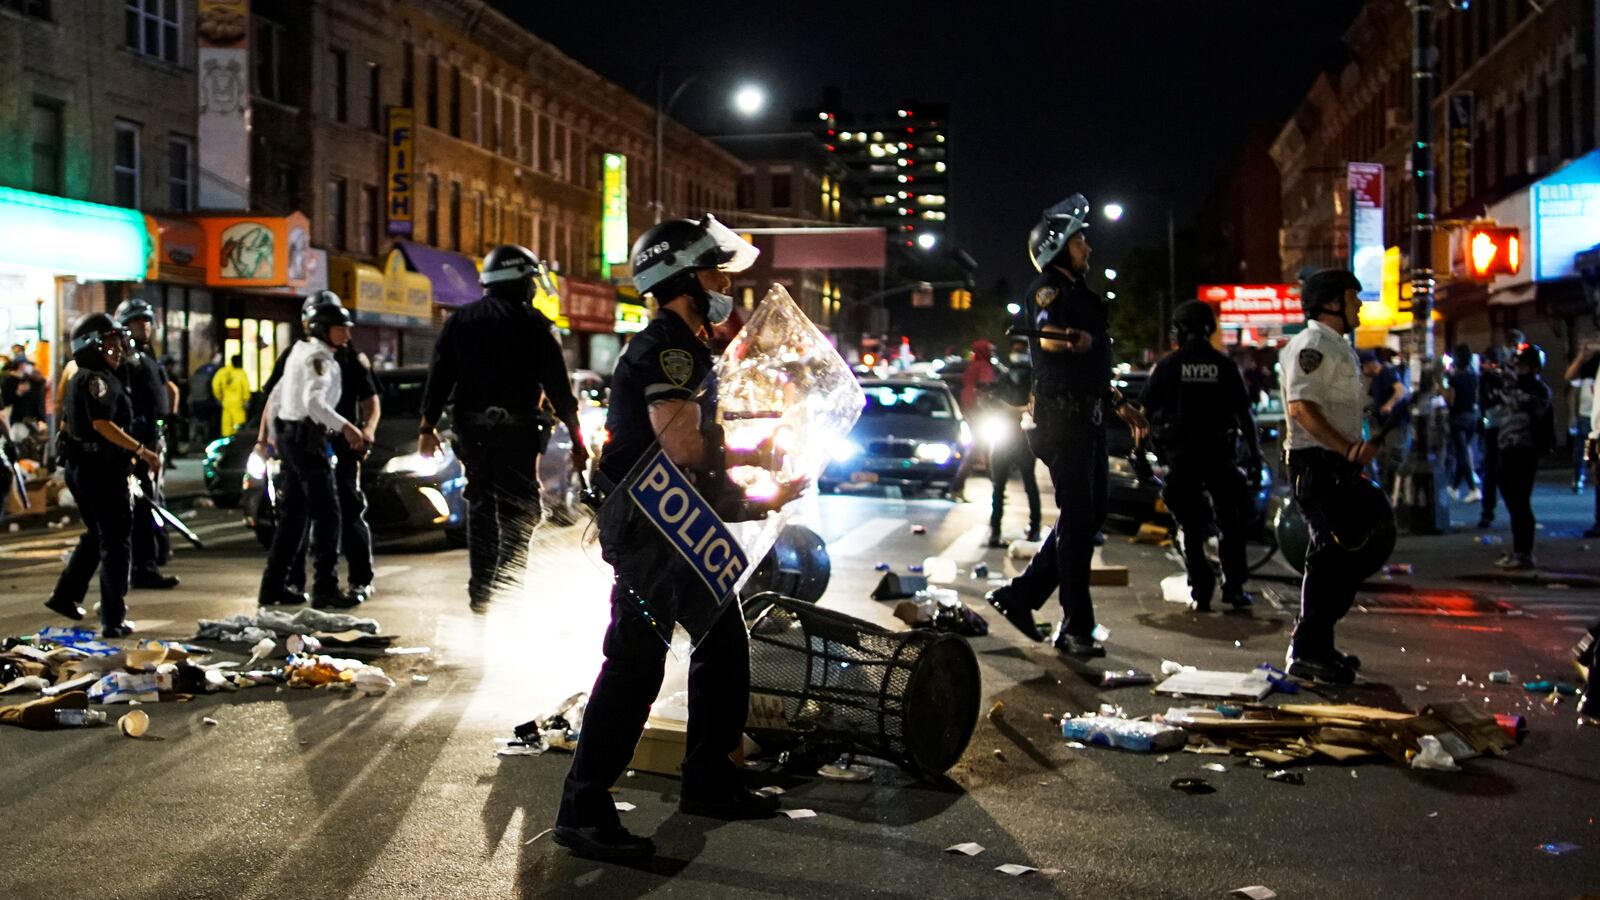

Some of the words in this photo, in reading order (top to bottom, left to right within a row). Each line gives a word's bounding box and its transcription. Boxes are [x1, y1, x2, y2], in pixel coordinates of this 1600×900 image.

[393, 128, 409, 214] FISH
[1181, 363, 1219, 377] NYPD
[638, 463, 743, 593] POLICE
